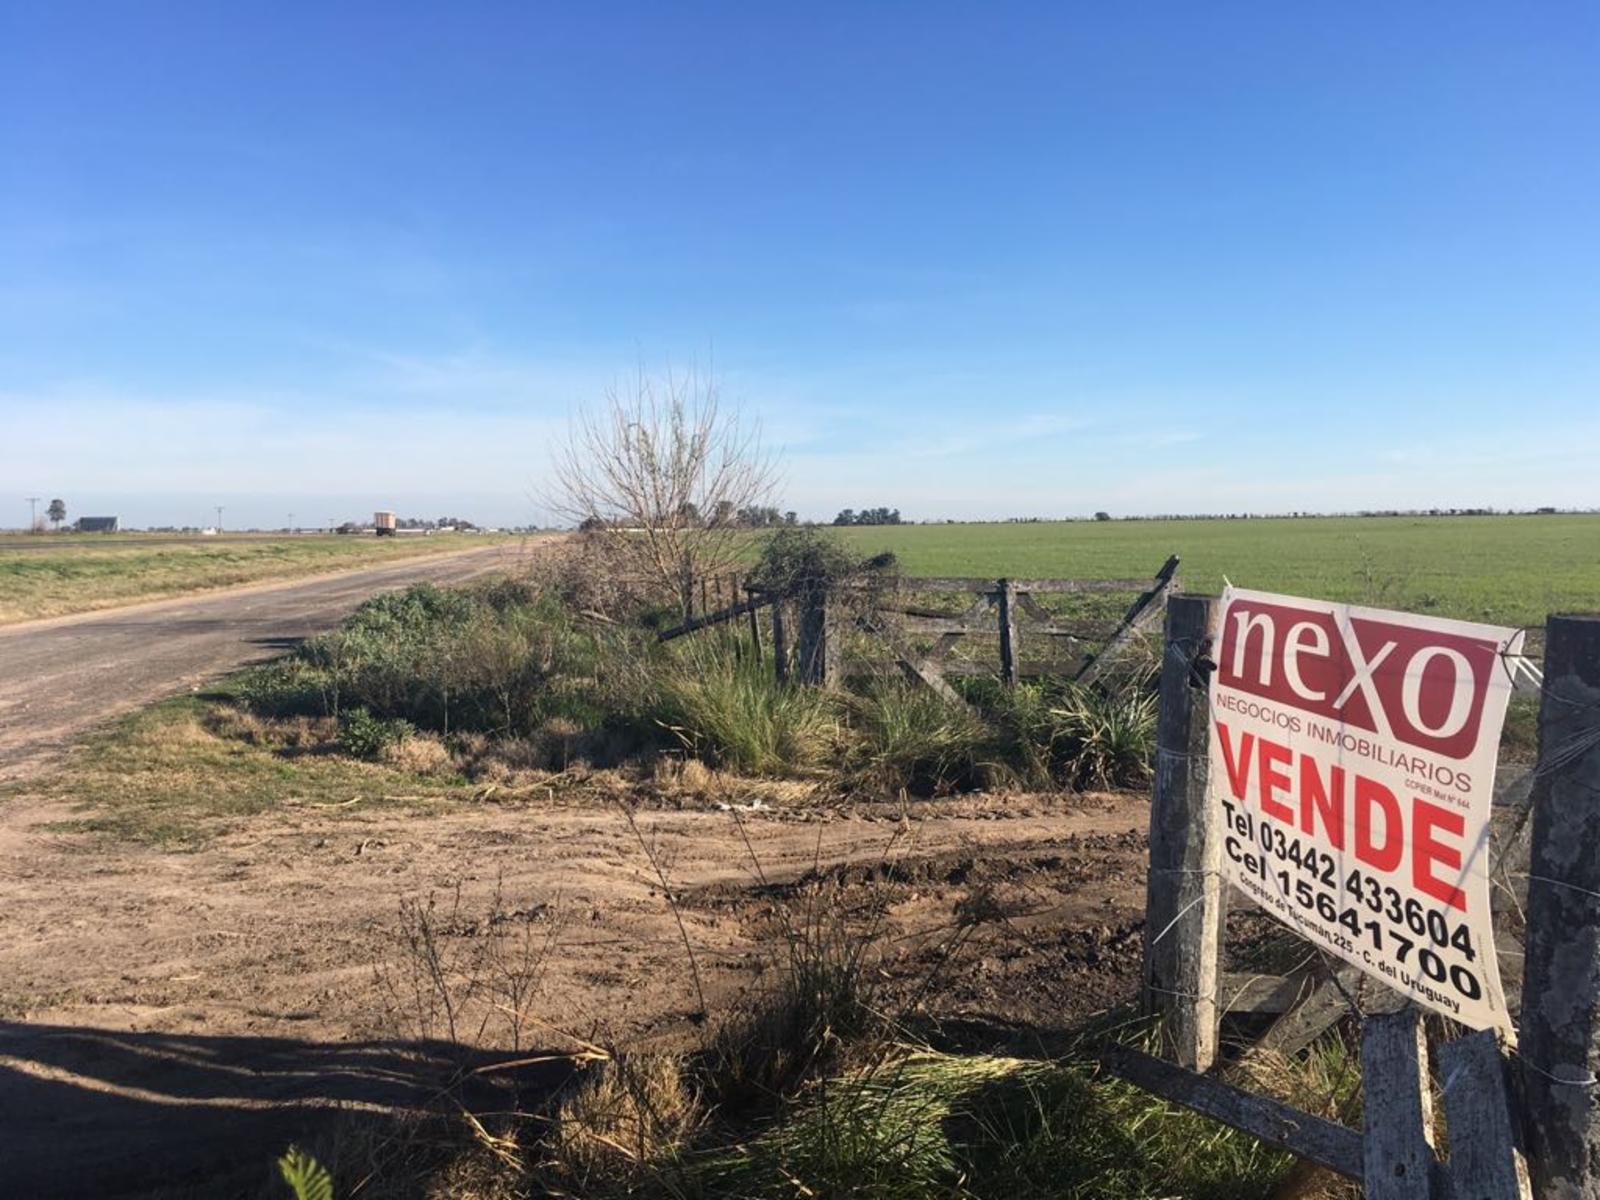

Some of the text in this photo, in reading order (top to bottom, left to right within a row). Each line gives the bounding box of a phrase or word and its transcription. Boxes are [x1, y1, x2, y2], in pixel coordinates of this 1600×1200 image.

[1217, 693, 1472, 793] NEGOCIOS INMOBILIARIOS
[1217, 721, 1467, 912] VENDE
[1222, 800, 1476, 962] Tel 03442 433604
[1225, 836, 1267, 880] Cel
[1278, 870, 1481, 1000] 15641700
[1240, 871, 1274, 904] Congreso
[1333, 932, 1354, 953] 225
[1363, 950, 1376, 967] C.
[1378, 959, 1397, 980] del
[1400, 970, 1460, 1014] Uruguay
